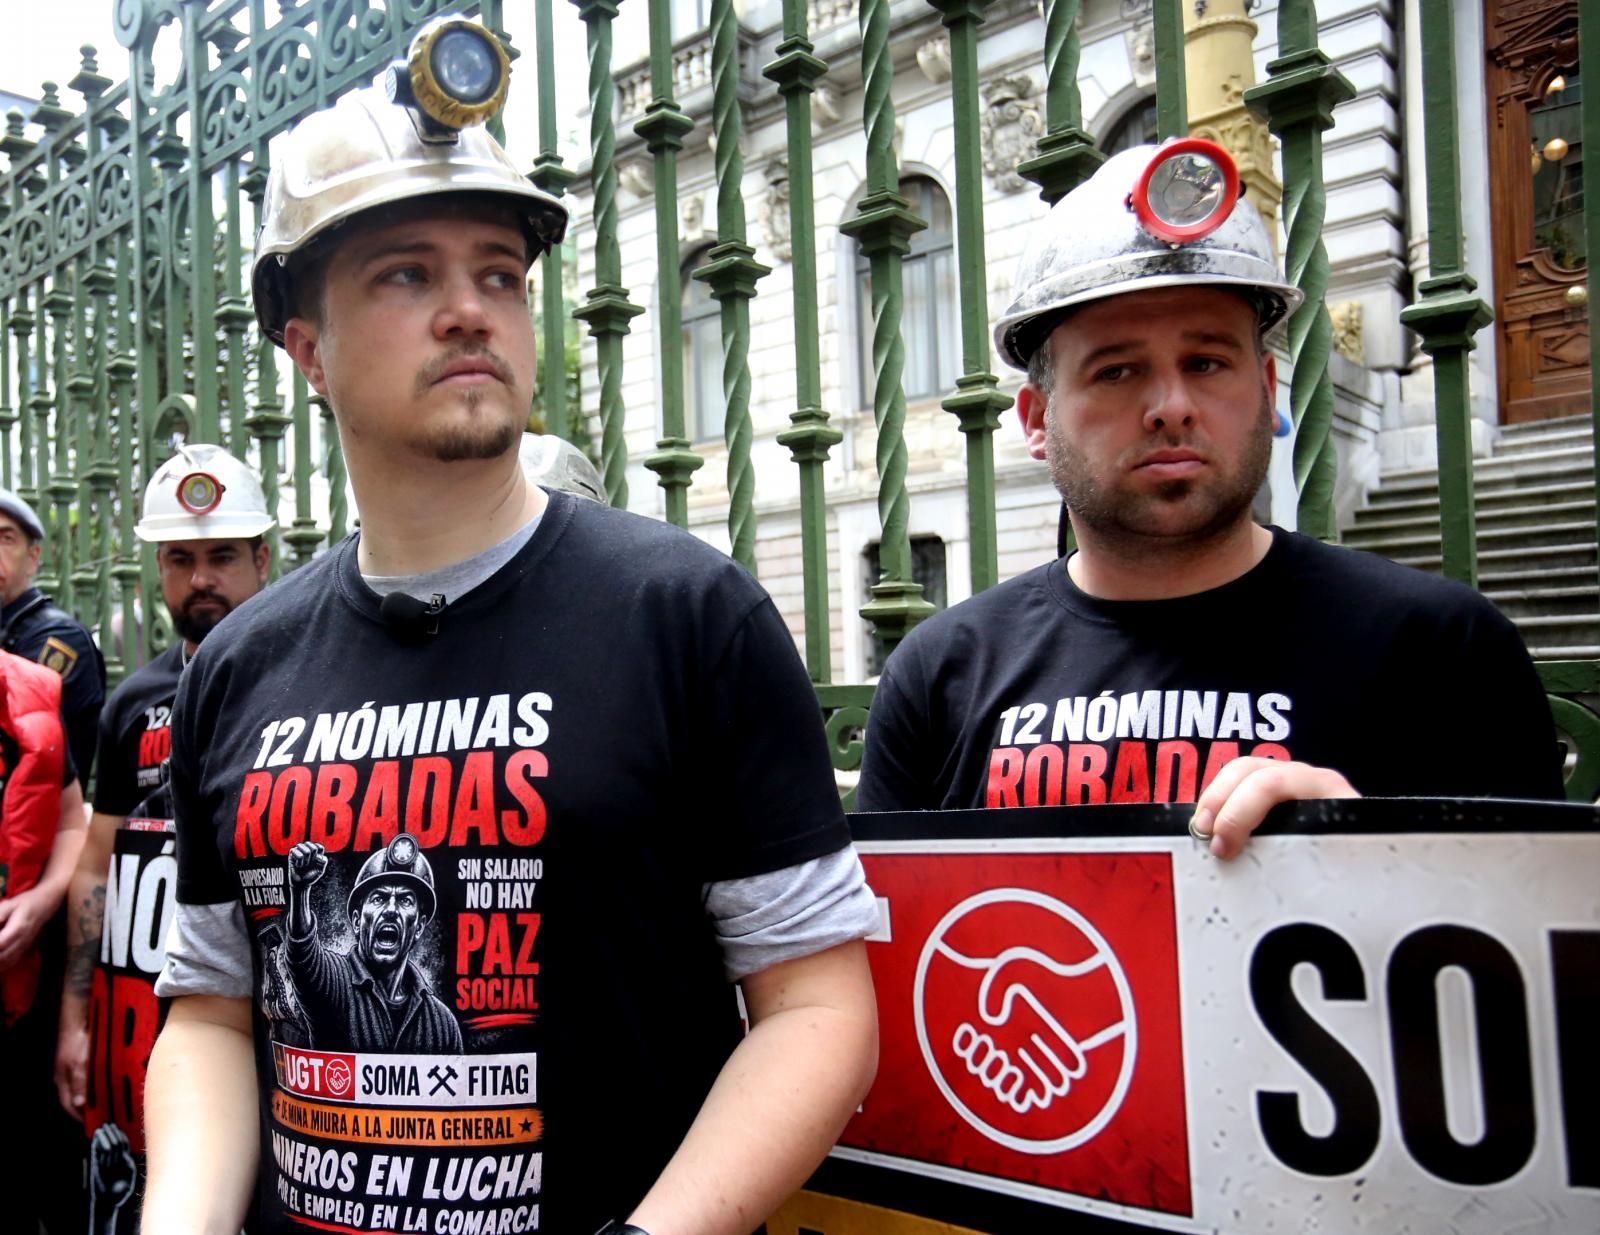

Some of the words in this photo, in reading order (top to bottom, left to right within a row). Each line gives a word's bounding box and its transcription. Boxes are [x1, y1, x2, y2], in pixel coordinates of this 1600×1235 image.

[253, 717, 306, 769] 12
[303, 692, 553, 763] NÓMINAS
[1000, 703, 1048, 745] 12
[1051, 690, 1291, 742] NÓMINAS
[985, 740, 1292, 809] ROBAD
[233, 750, 549, 859] ROBADAS
[239, 867, 284, 887] EMPRESARIO
[458, 859, 482, 880] SIN
[484, 859, 543, 880] SALARIO
[244, 889, 251, 906] A
[251, 888, 262, 905] LA
[263, 887, 286, 905] FUGA
[465, 884, 494, 909] NO
[497, 883, 536, 909] HAY
[456, 913, 541, 975] PAZ
[456, 978, 539, 1010] SOCIAL
[286, 1053, 323, 1091] UGT
[362, 1064, 420, 1096] SOMA
[468, 1064, 529, 1096] FITAG
[288, 1104, 308, 1128] MINA
[311, 1109, 348, 1135] MIURA
[352, 1115, 360, 1136] A
[365, 1116, 382, 1138] LA
[386, 1117, 436, 1140] JUNTA
[441, 1116, 514, 1140] GENERAL
[272, 1128, 358, 1192] MINEROS
[365, 1155, 413, 1197] EN
[422, 1152, 543, 1201] LUCHA
[277, 1173, 289, 1205] POR
[289, 1186, 300, 1212] EL
[304, 1193, 364, 1227] EMPLEO
[370, 1204, 398, 1231] EN
[402, 1206, 428, 1232] LA
[434, 1203, 540, 1235] COMARCA
